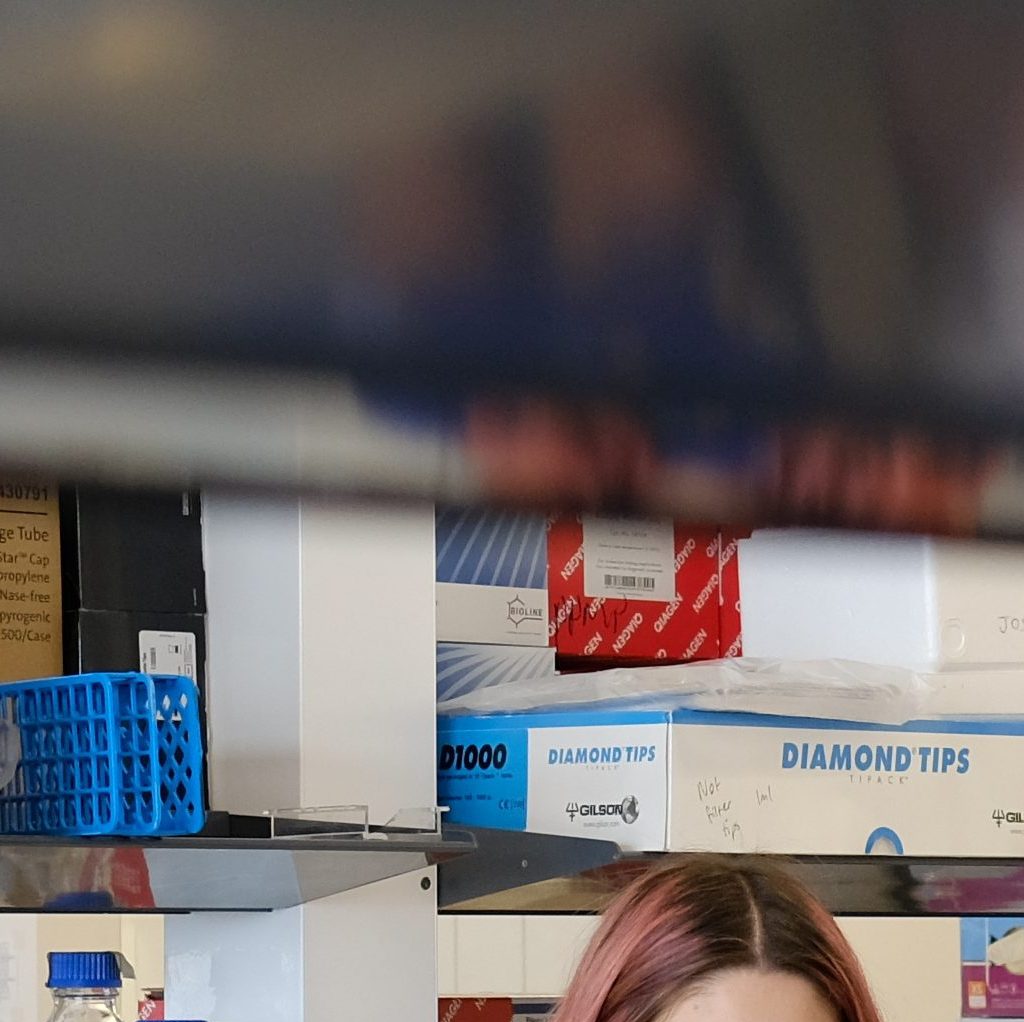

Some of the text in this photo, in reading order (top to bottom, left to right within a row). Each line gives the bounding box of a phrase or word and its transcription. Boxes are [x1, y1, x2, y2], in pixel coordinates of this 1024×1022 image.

[17, 525, 49, 542] Tube
[29, 553, 50, 568] Cap
[691, 573, 719, 613] QIAGEN
[510, 607, 543, 617] BIOLINE
[612, 612, 643, 654] QIAGEN
[439, 743, 507, 771] D1000
[548, 745, 656, 765] DIAMOND TIPS
[782, 742, 970, 774] DIAMOND TIPS
[579, 804, 623, 817] GILSON
